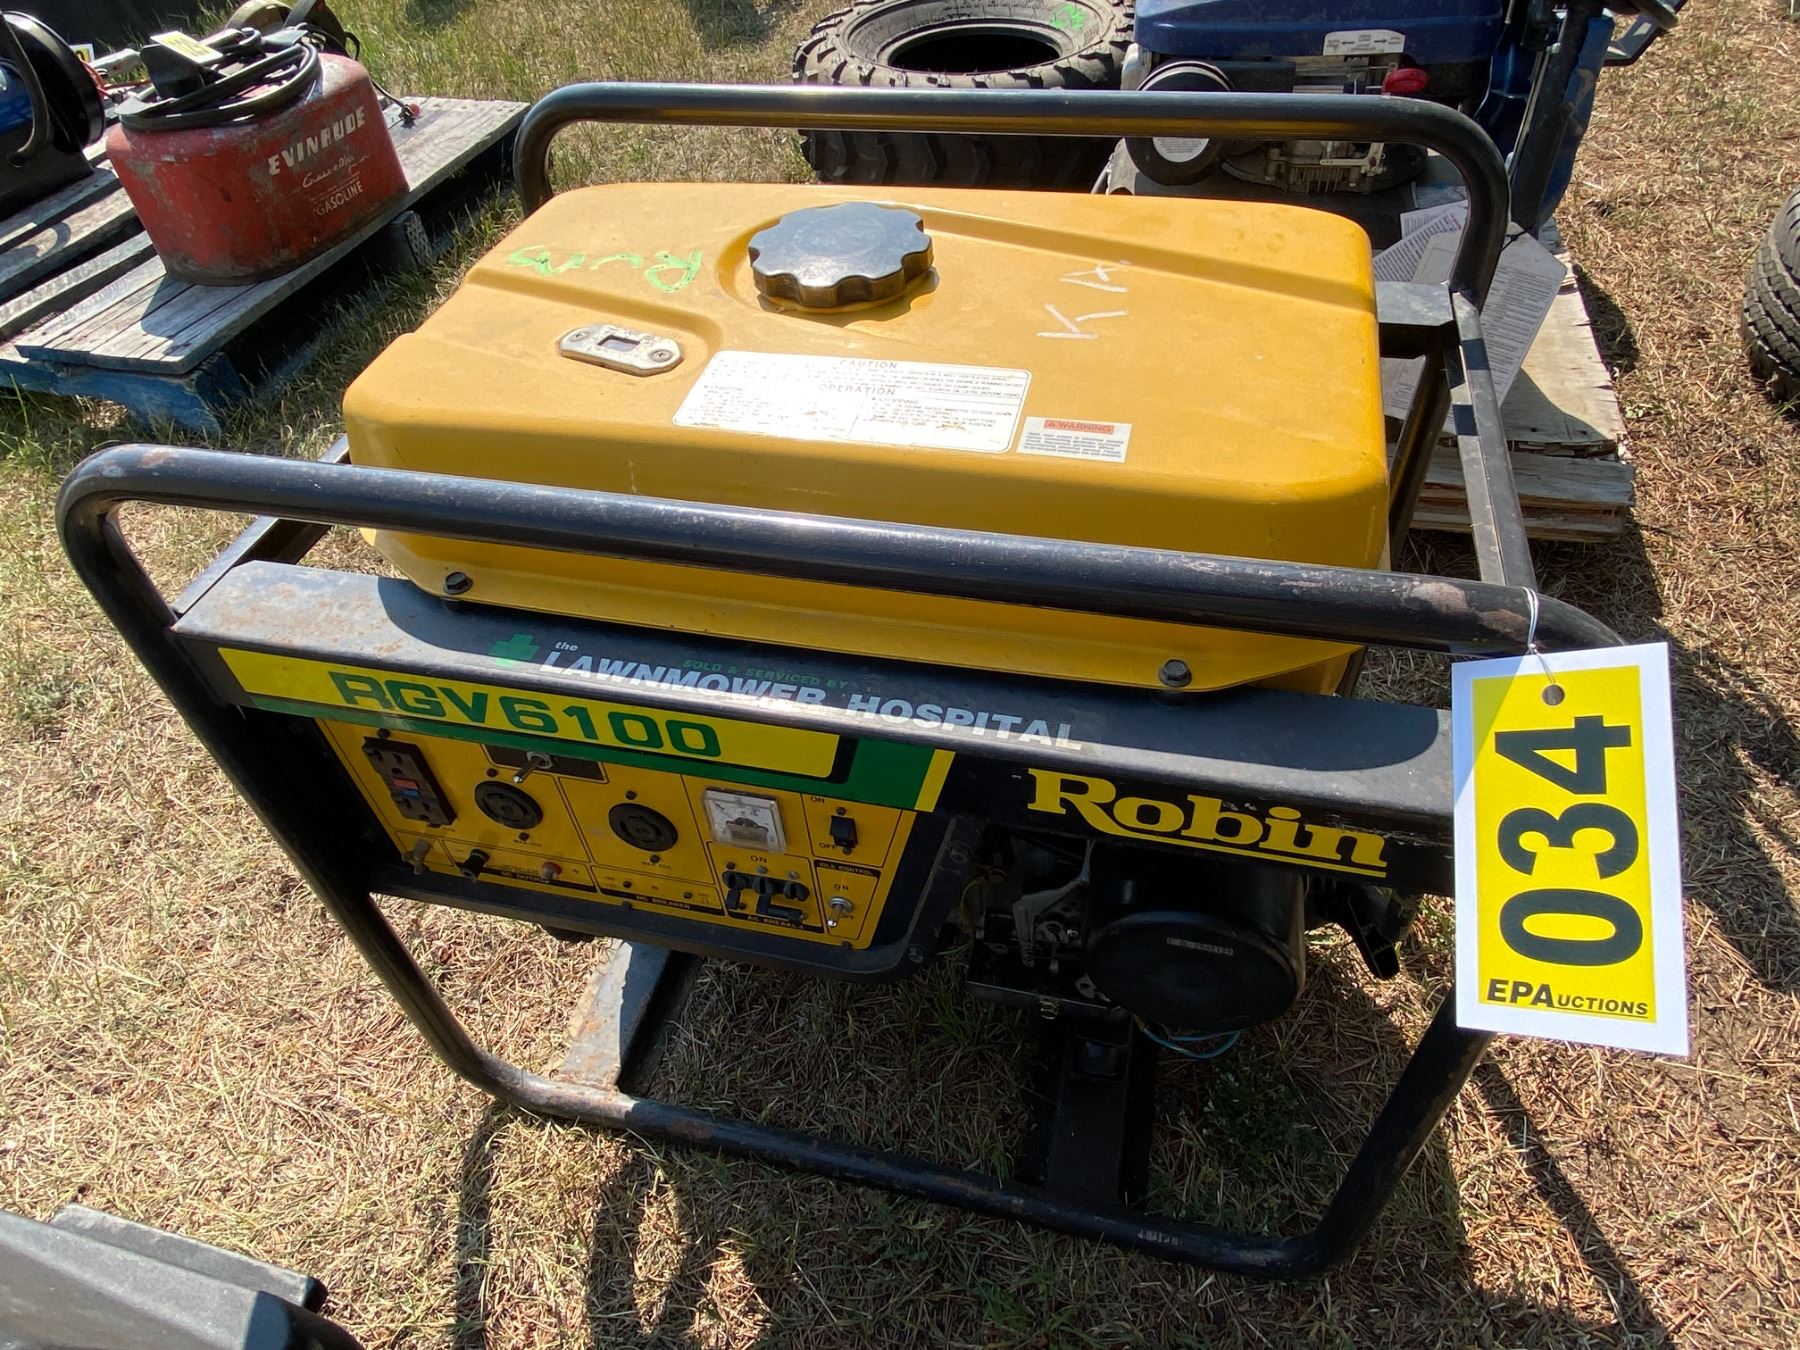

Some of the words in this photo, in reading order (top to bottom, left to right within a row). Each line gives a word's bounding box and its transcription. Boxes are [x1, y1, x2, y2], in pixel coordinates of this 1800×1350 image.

[267, 106, 365, 176] EVINRUDE
[316, 181, 364, 216] GASOLINE
[839, 359, 899, 370] CAUTION
[818, 384, 896, 396] OPERATION
[1059, 421, 1112, 433] WARNING
[555, 640, 579, 652] the
[683, 659, 722, 672] SOLD
[728, 666, 738, 674] &
[745, 667, 821, 686] SERVICED
[826, 679, 849, 690] BY
[539, 651, 827, 709] LAWNMOWER
[845, 693, 1082, 751] HOSPITAL
[328, 670, 722, 758] RGV6100
[810, 796, 826, 804] ON
[1027, 767, 1388, 878] Robin
[818, 841, 838, 850] OFF
[1494, 715, 1643, 967] 034
[749, 855, 768, 864] ON
[838, 865, 874, 877] CONTROL
[833, 883, 849, 891] ON
